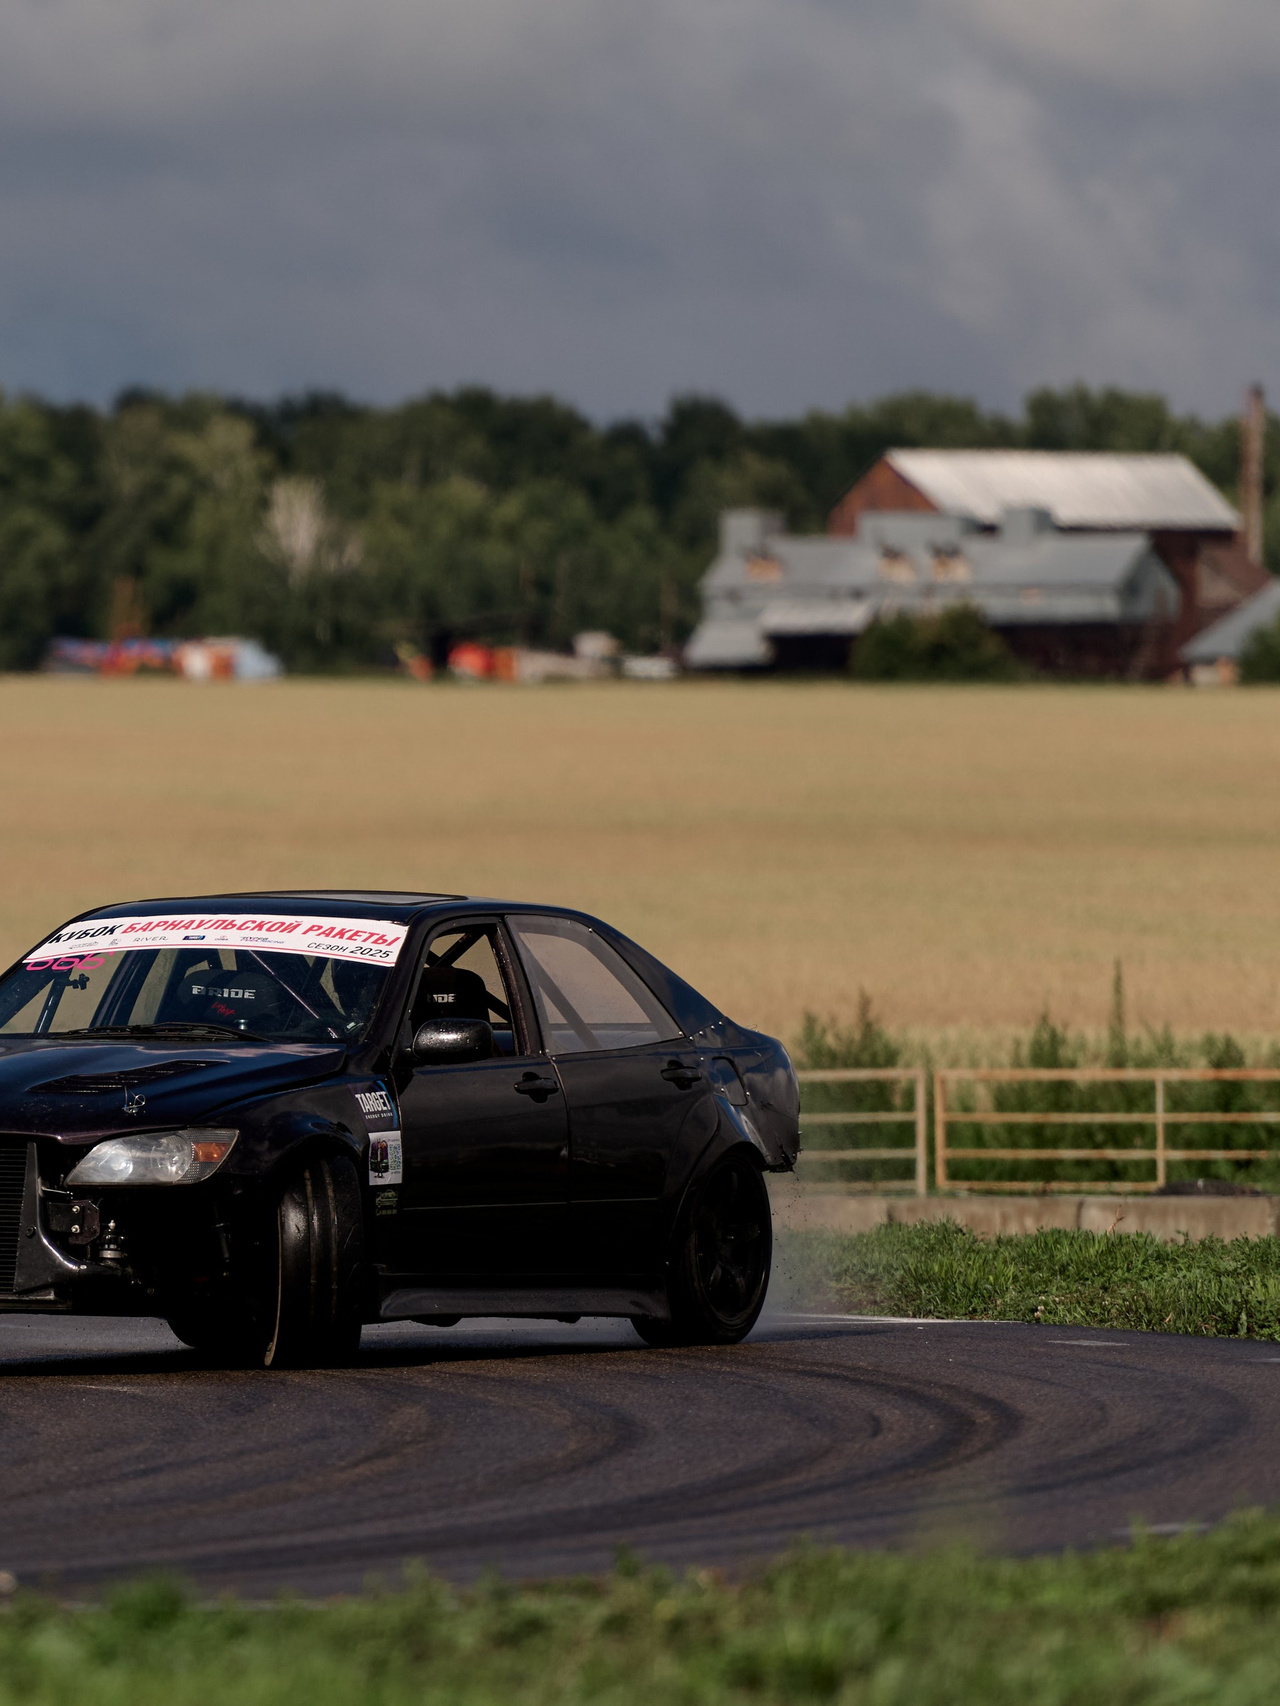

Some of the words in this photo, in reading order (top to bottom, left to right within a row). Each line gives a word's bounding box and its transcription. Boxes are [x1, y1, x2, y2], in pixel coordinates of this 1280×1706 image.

[48, 924, 123, 944] КУБОК
[120, 919, 303, 934] БАРНАУЛЬСКОЙ
[301, 924, 402, 947] РАКЕТЫ
[306, 941, 350, 953] СЕЗОН
[348, 945, 394, 960] 2025
[191, 985, 256, 999] BRIDE
[355, 1092, 392, 1113] TARGET
